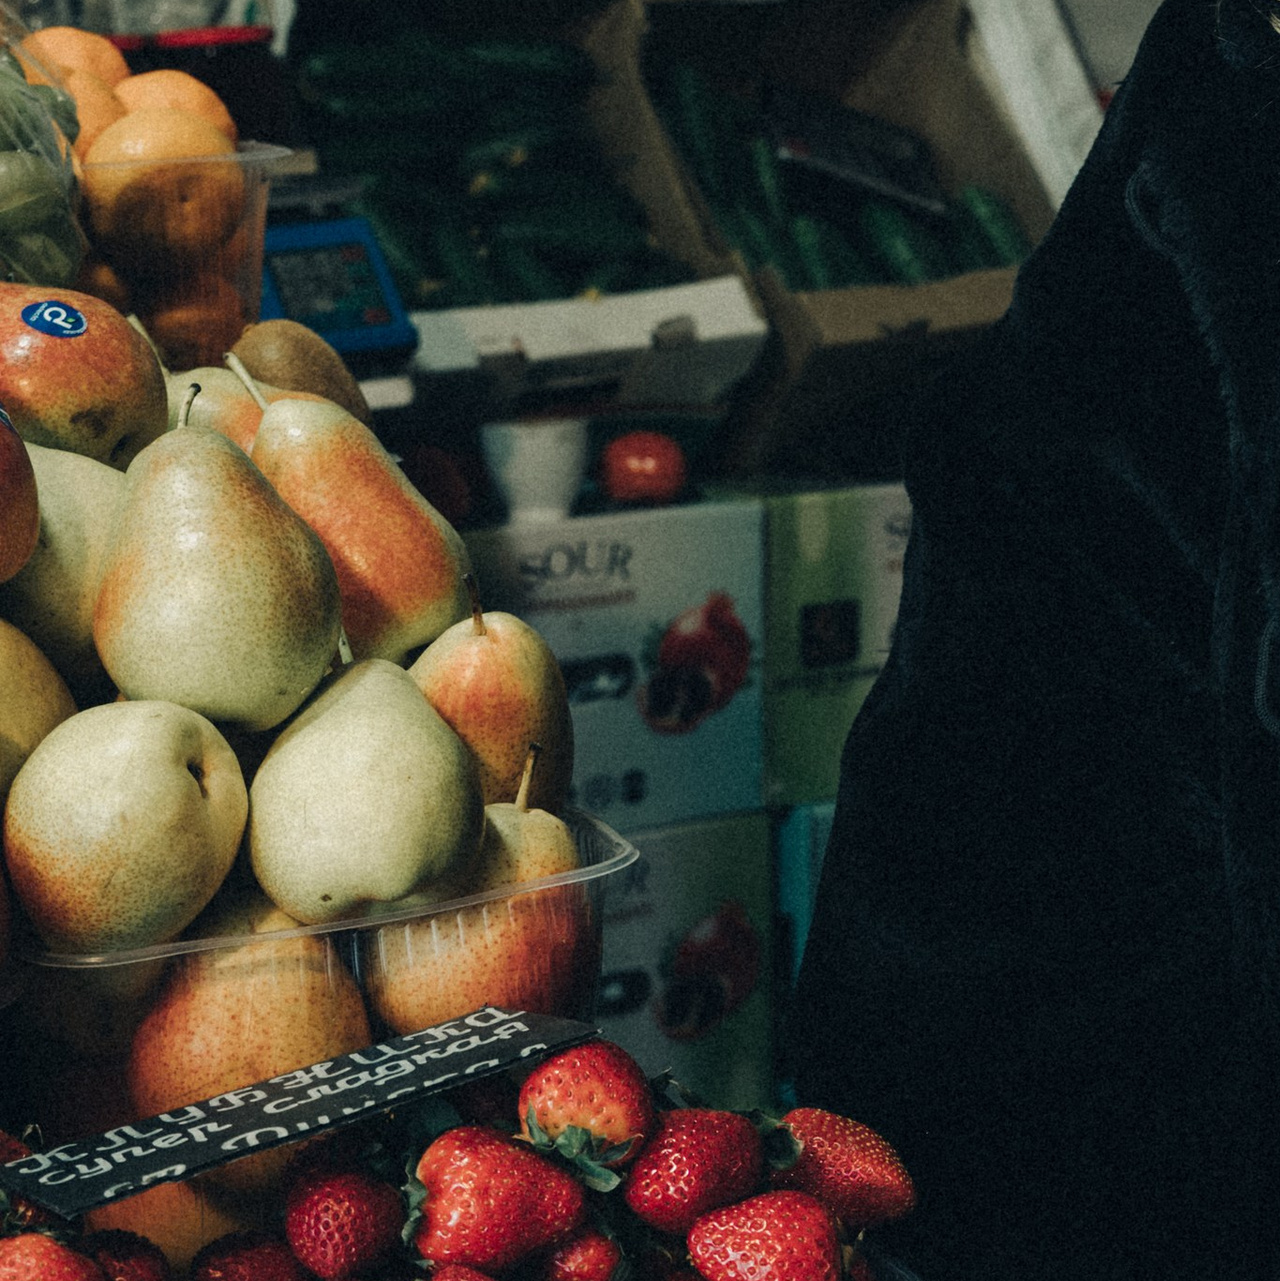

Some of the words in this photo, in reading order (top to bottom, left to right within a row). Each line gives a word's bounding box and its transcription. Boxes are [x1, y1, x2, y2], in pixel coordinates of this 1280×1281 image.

[4, 1005, 527, 1174] КЛУБНИКА
[38, 1121, 234, 1186] супер
[263, 1020, 530, 1115] сладкая
